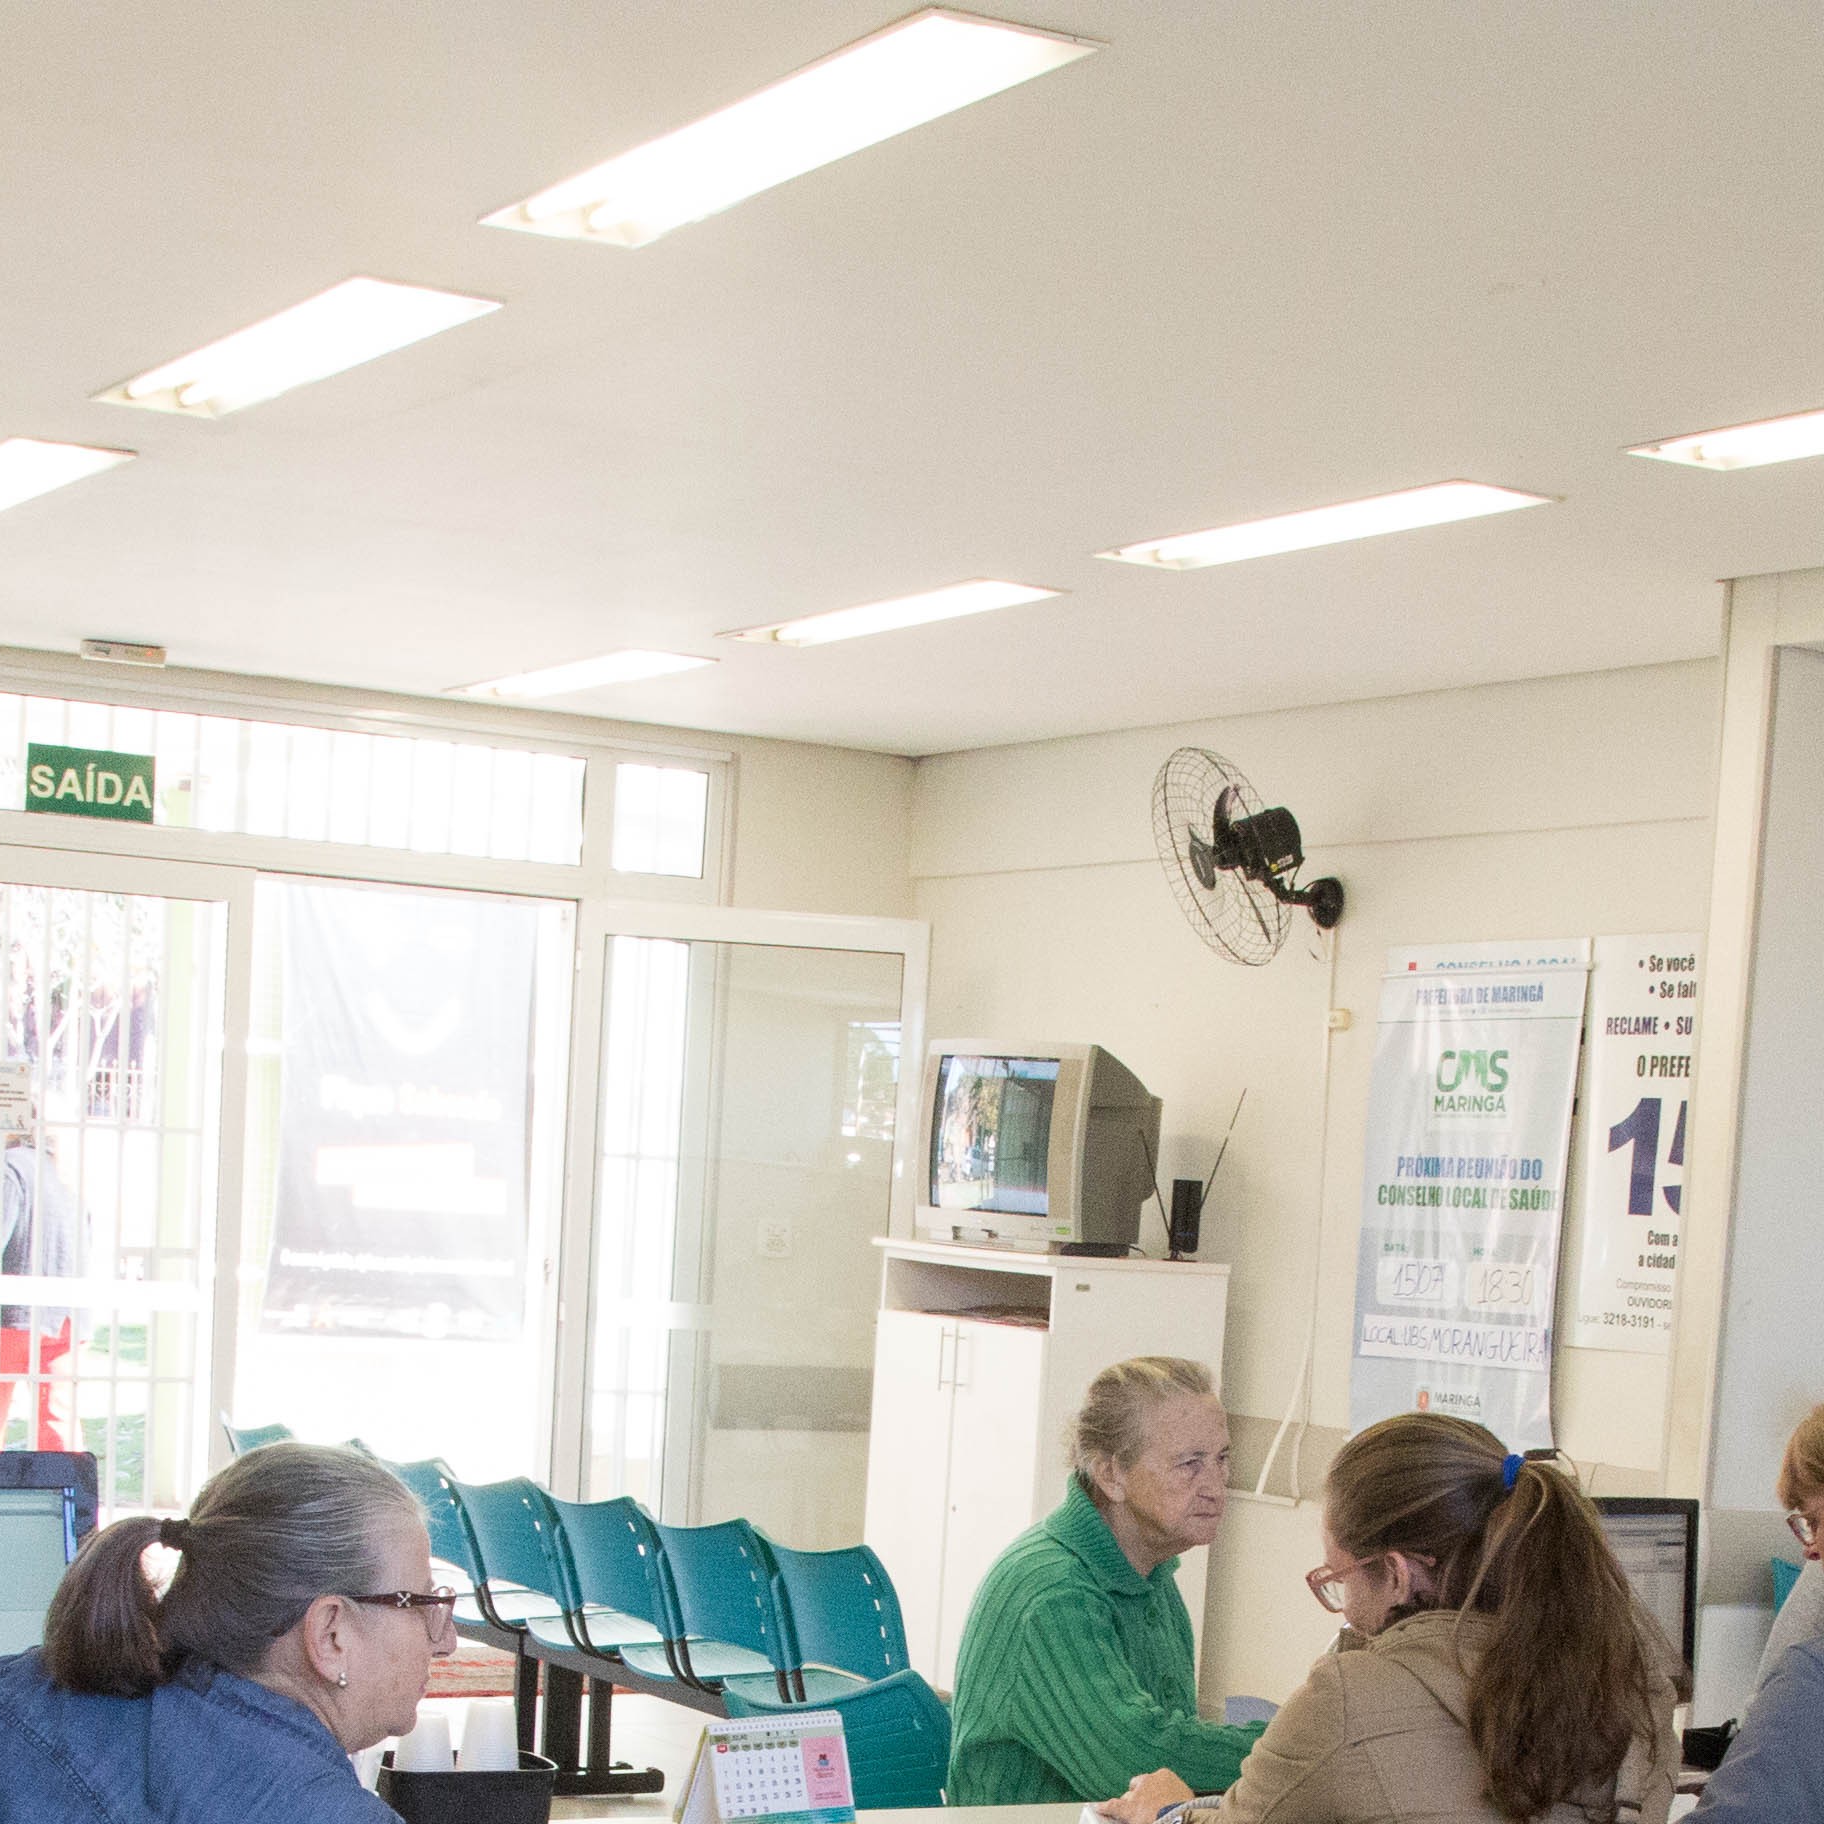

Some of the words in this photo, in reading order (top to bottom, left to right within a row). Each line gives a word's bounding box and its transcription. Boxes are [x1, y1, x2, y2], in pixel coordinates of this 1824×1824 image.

[29, 762, 152, 809] SAÍDA
[1649, 955, 1664, 972] Se
[1666, 953, 1696, 972] você
[1476, 986, 1489, 1004] DE
[1491, 982, 1544, 1003] MARINGÁ
[1660, 981, 1674, 998] Se
[1606, 1016, 1659, 1035] RECLAME
[1676, 1016, 1693, 1035] SU
[1637, 1055, 1646, 1077] O
[1650, 1055, 1691, 1077] PREFE
[1434, 1093, 1506, 1113] MARINGÁ
[1397, 1153, 1455, 1178] PRÓXIMA
[1457, 1154, 1517, 1180] REUNIÃO
[1520, 1158, 1543, 1181] DO
[1378, 1184, 1443, 1208] CONSELHO
[1445, 1186, 1488, 1209] LOCAL
[1509, 1186, 1559, 1211] SAÚDE
[1647, 1230, 1669, 1246] Com
[1638, 1254, 1644, 1267] a
[1603, 1312, 1654, 1329] 3218-3191
